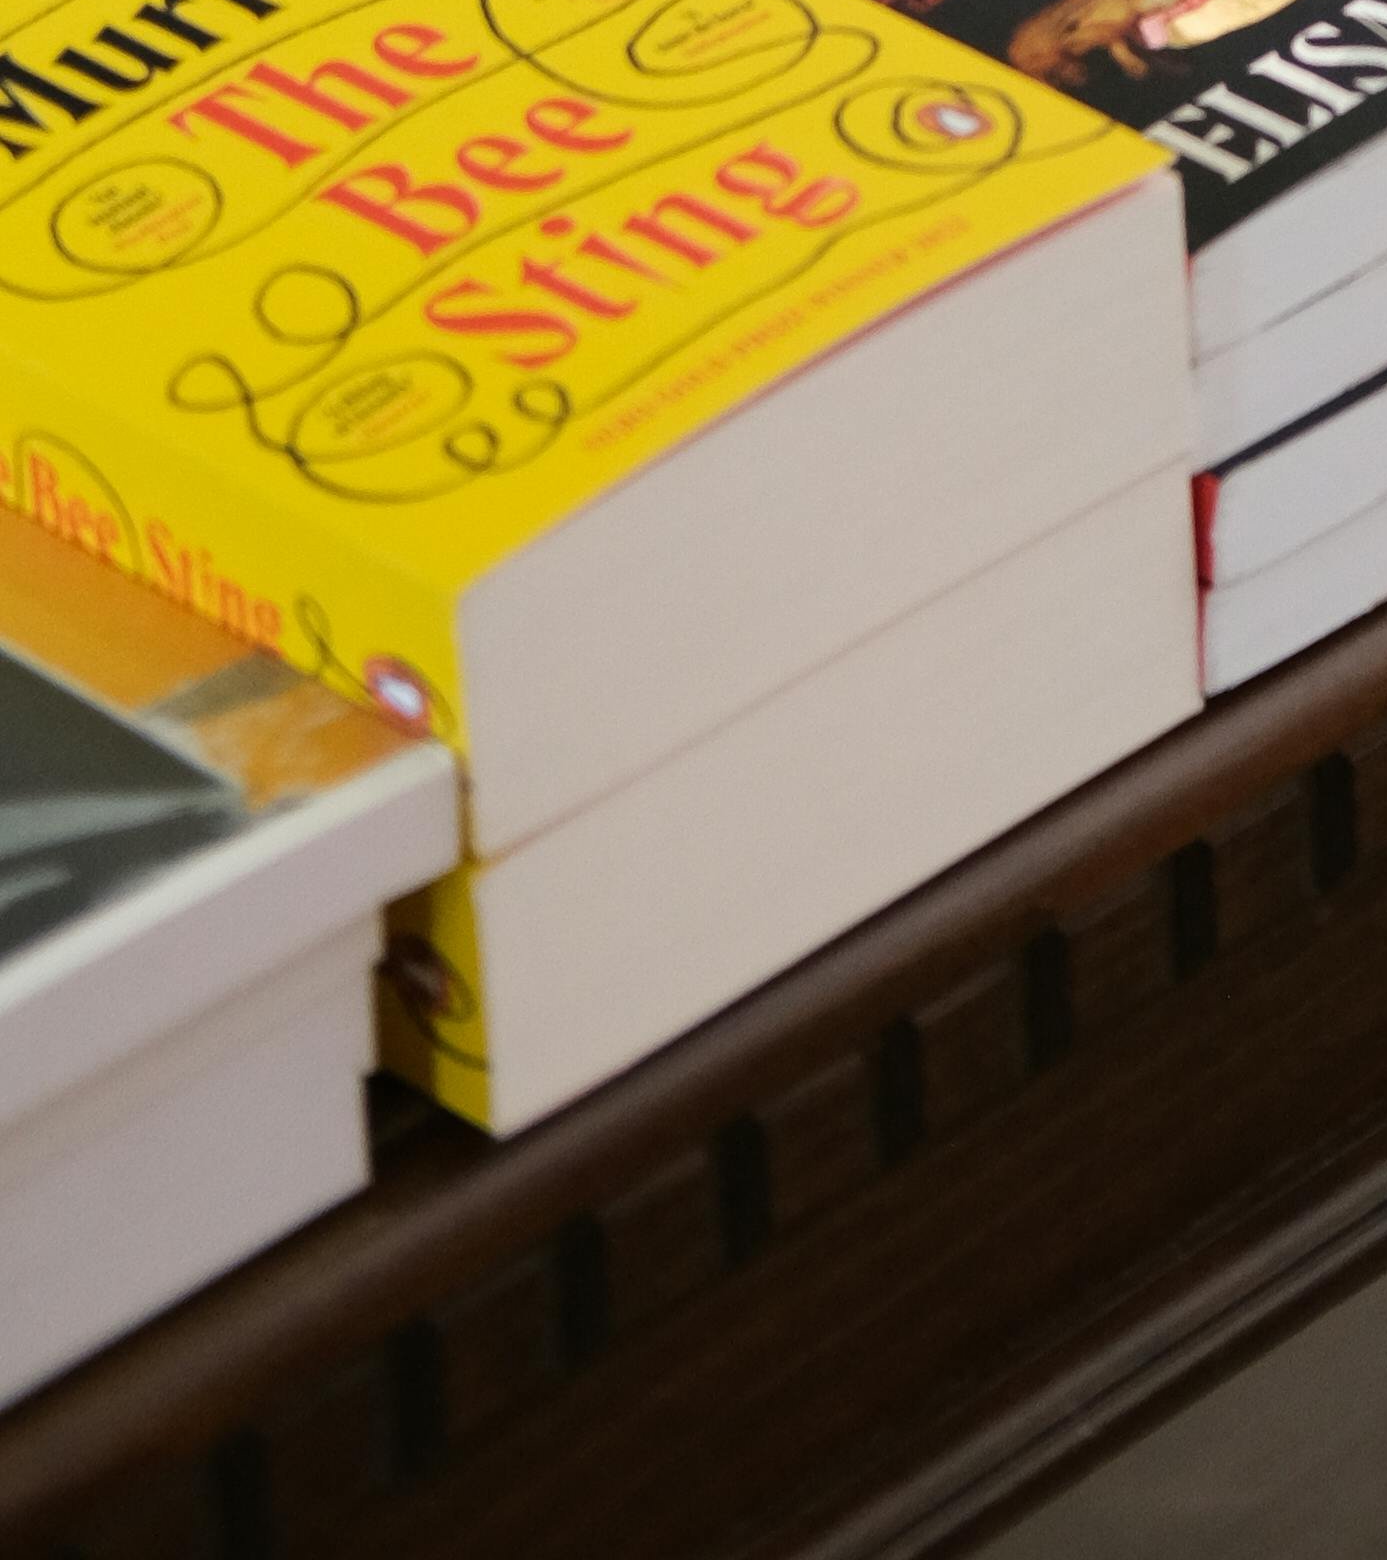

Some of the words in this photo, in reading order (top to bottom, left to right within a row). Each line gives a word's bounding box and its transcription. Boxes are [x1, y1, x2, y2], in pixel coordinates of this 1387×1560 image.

[168, 20, 480, 171] The
[321, 94, 634, 259] Bee
[424, 138, 861, 372] Sting
